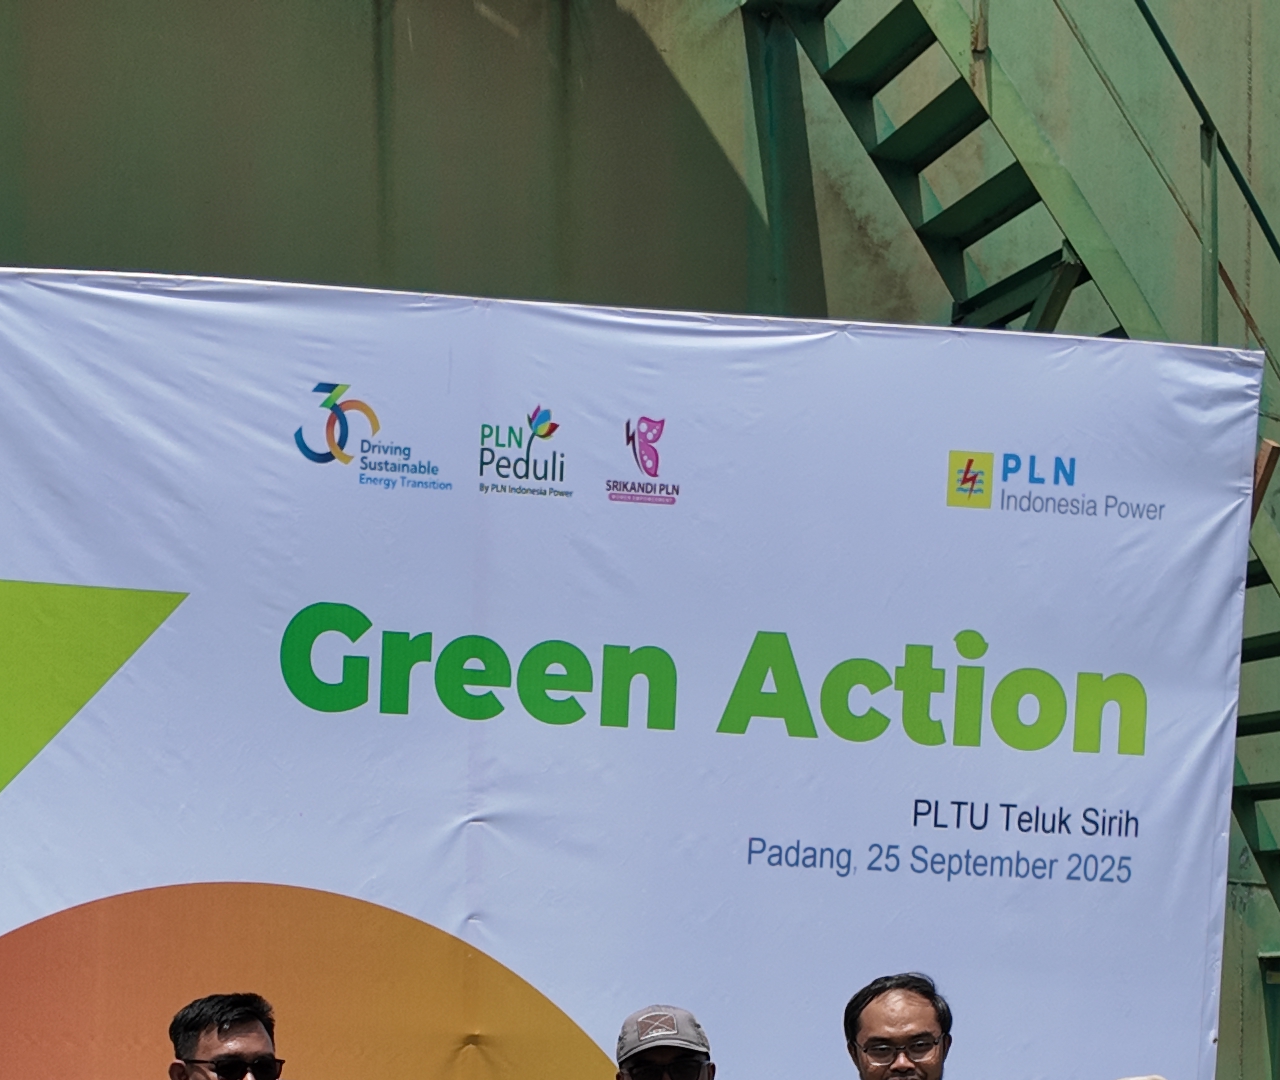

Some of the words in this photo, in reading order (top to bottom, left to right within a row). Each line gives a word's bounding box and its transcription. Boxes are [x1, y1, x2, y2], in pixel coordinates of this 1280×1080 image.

[360, 439, 411, 461] Driving
[480, 423, 523, 449] PLN
[359, 456, 439, 475] Sustainable
[479, 446, 565, 482] Peduli
[1001, 453, 1076, 487] PLN
[358, 473, 397, 490] Energy
[400, 476, 453, 490] Transition
[479, 483, 489, 494] By
[491, 484, 507, 493] PLN
[508, 485, 547, 496] Indonesia
[548, 488, 573, 497] Power
[605, 480, 657, 494] SRIKANDI
[658, 484, 680, 496] PLN
[1000, 489, 1098, 516] Indonesia
[1104, 495, 1166, 520] Power
[279, 601, 678, 732] Green
[715, 628, 1148, 756] Action
[913, 799, 989, 831] PLTU
[999, 803, 1072, 834] Teluk
[1081, 807, 1139, 838] Sirih
[747, 837, 857, 878] Padang,
[867, 843, 900, 872] 25
[910, 845, 1058, 882] September
[1066, 853, 1132, 883] 2025
